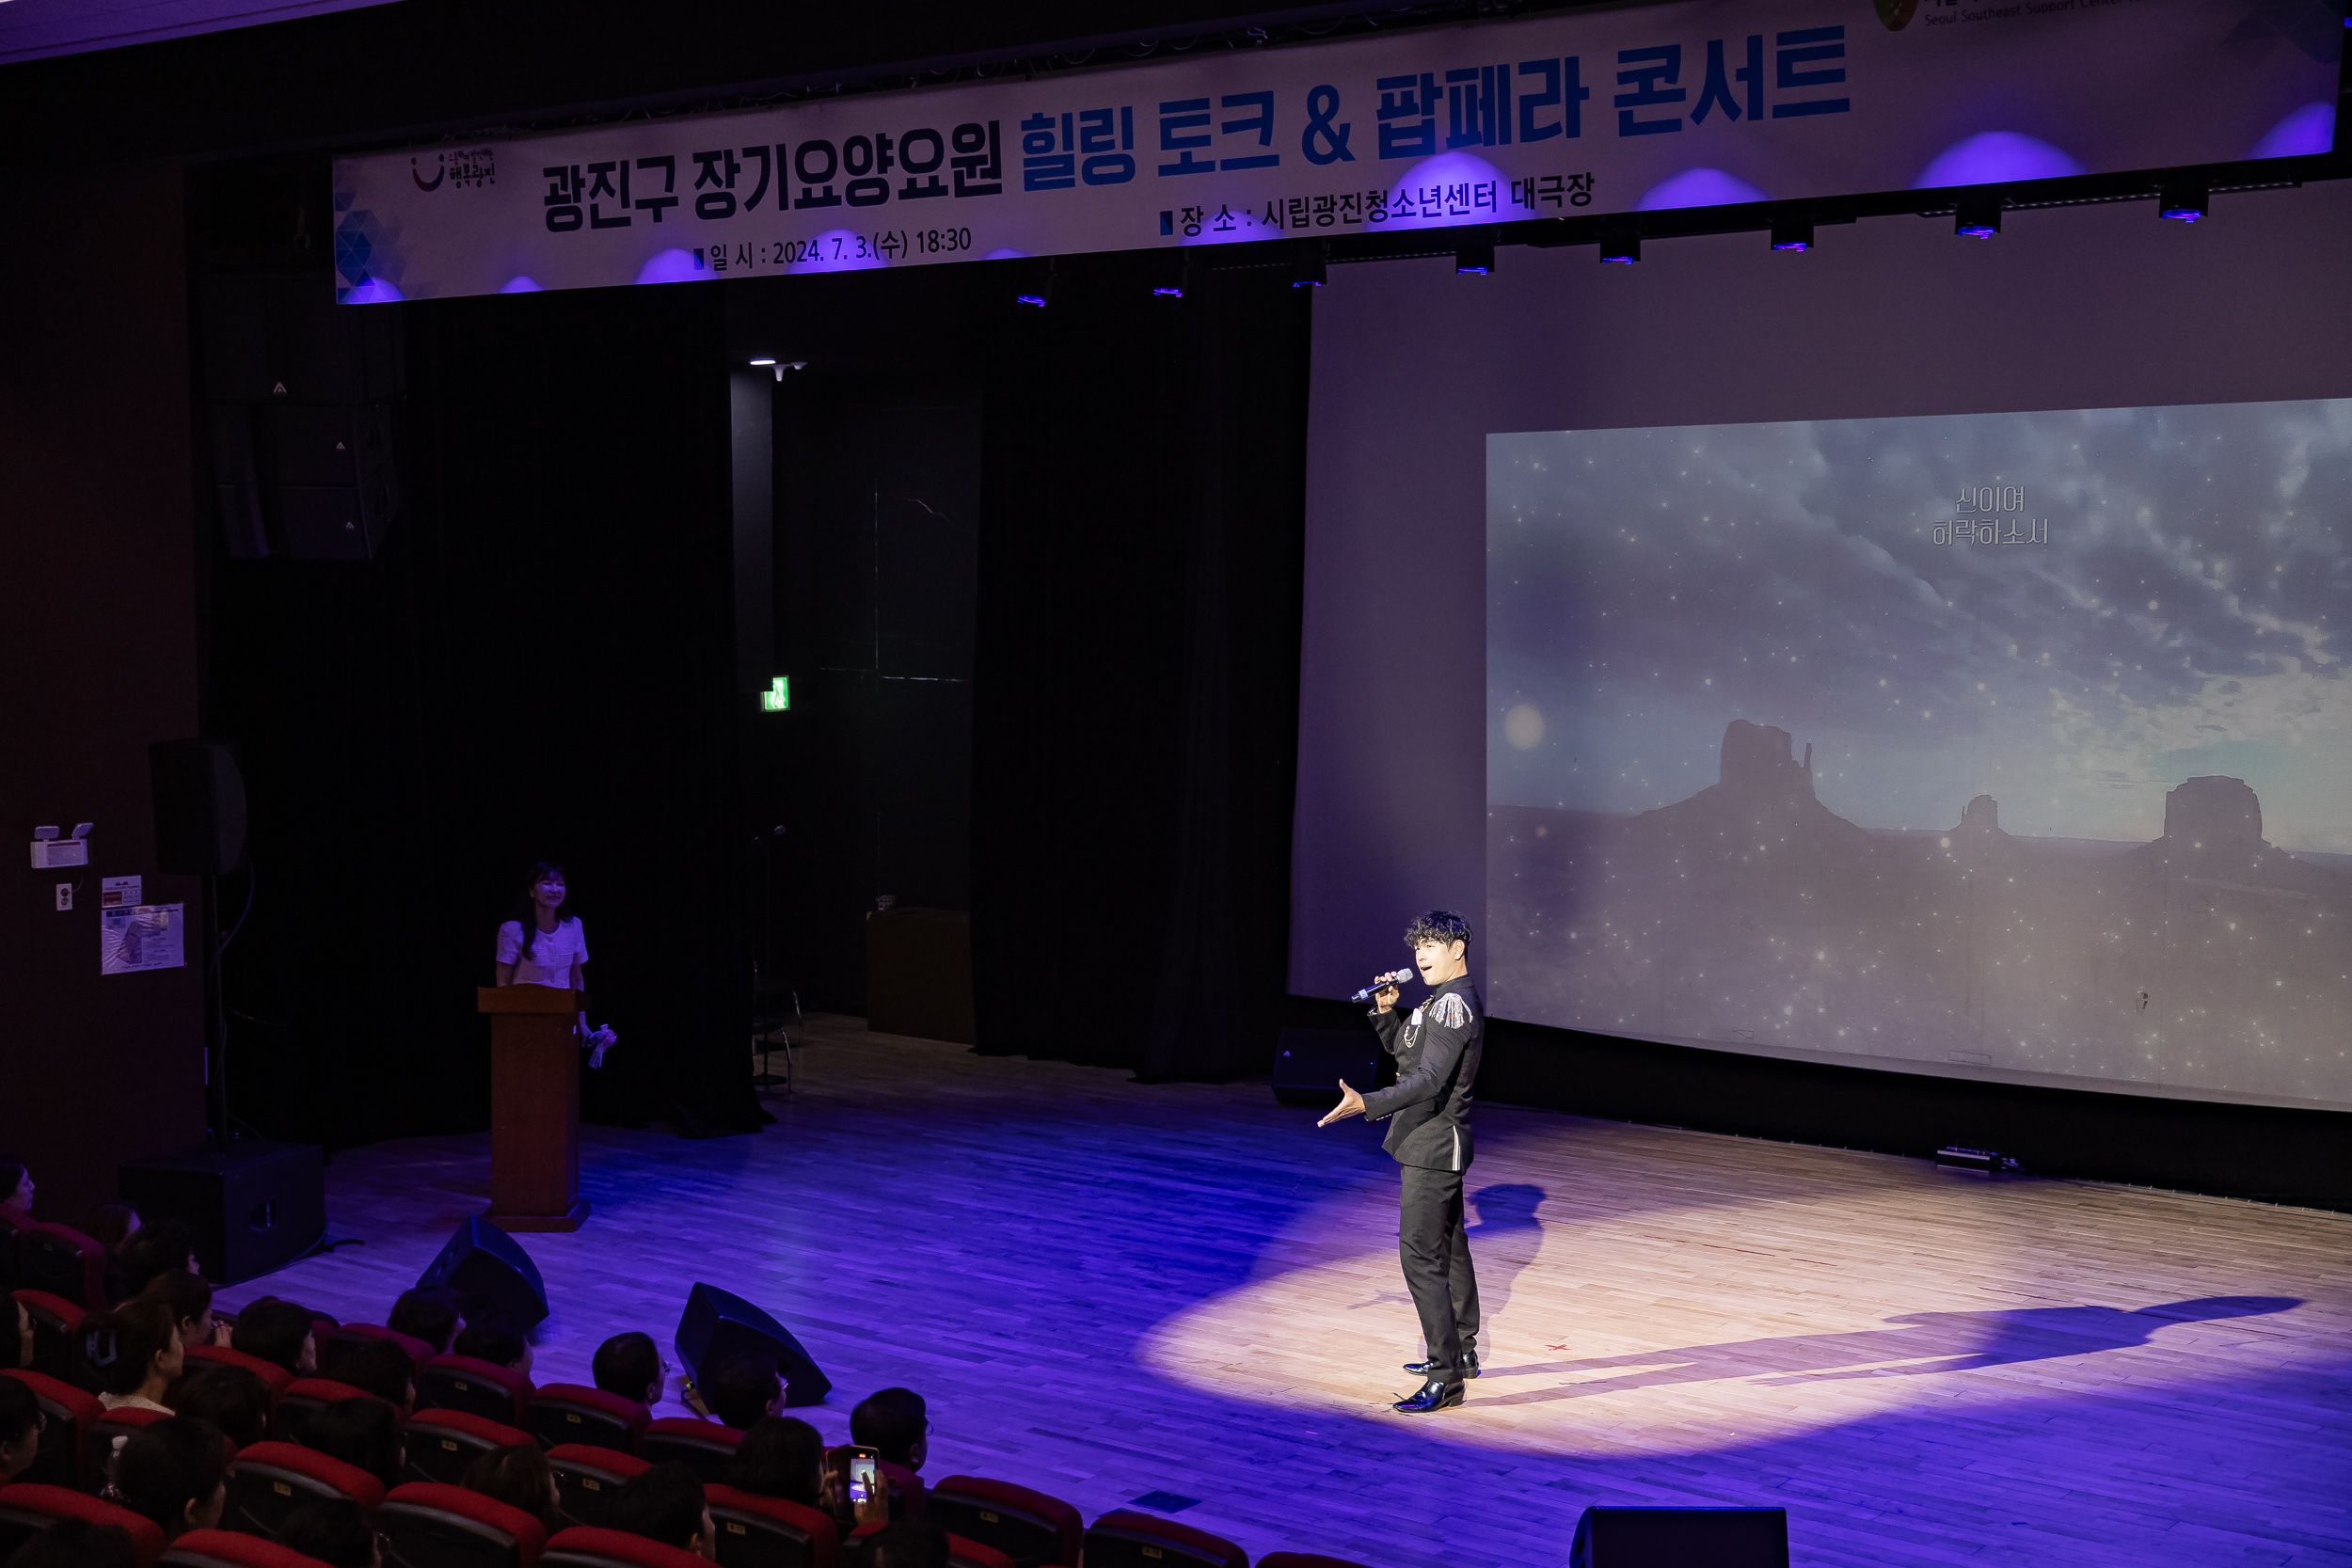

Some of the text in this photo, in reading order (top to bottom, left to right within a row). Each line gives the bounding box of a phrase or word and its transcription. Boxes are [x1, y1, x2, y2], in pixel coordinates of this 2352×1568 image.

[1925, 11, 1956, 26] Seoul
[1962, 5, 2021, 23] Southeast
[2026, 0, 2075, 17] Support
[543, 24, 1851, 233] 광진구 장기요양요원 힐링 토크 & 팝페라 콘서트
[450, 163, 495, 189] 행복광진
[1181, 206, 1204, 237] 장
[1213, 204, 1237, 232] 소
[1262, 180, 1498, 231] 시립광진청소년센터
[1510, 172, 1596, 211] 대극장
[710, 245, 728, 271] 일
[735, 242, 753, 269] 시
[773, 239, 824, 265] 2024.
[831, 237, 849, 261] 7.
[855, 230, 908, 261] 3.(수)
[915, 227, 971, 254] 18:30
[1956, 485, 2025, 514] 신이여
[1932, 518, 2049, 546] 허락하소서
